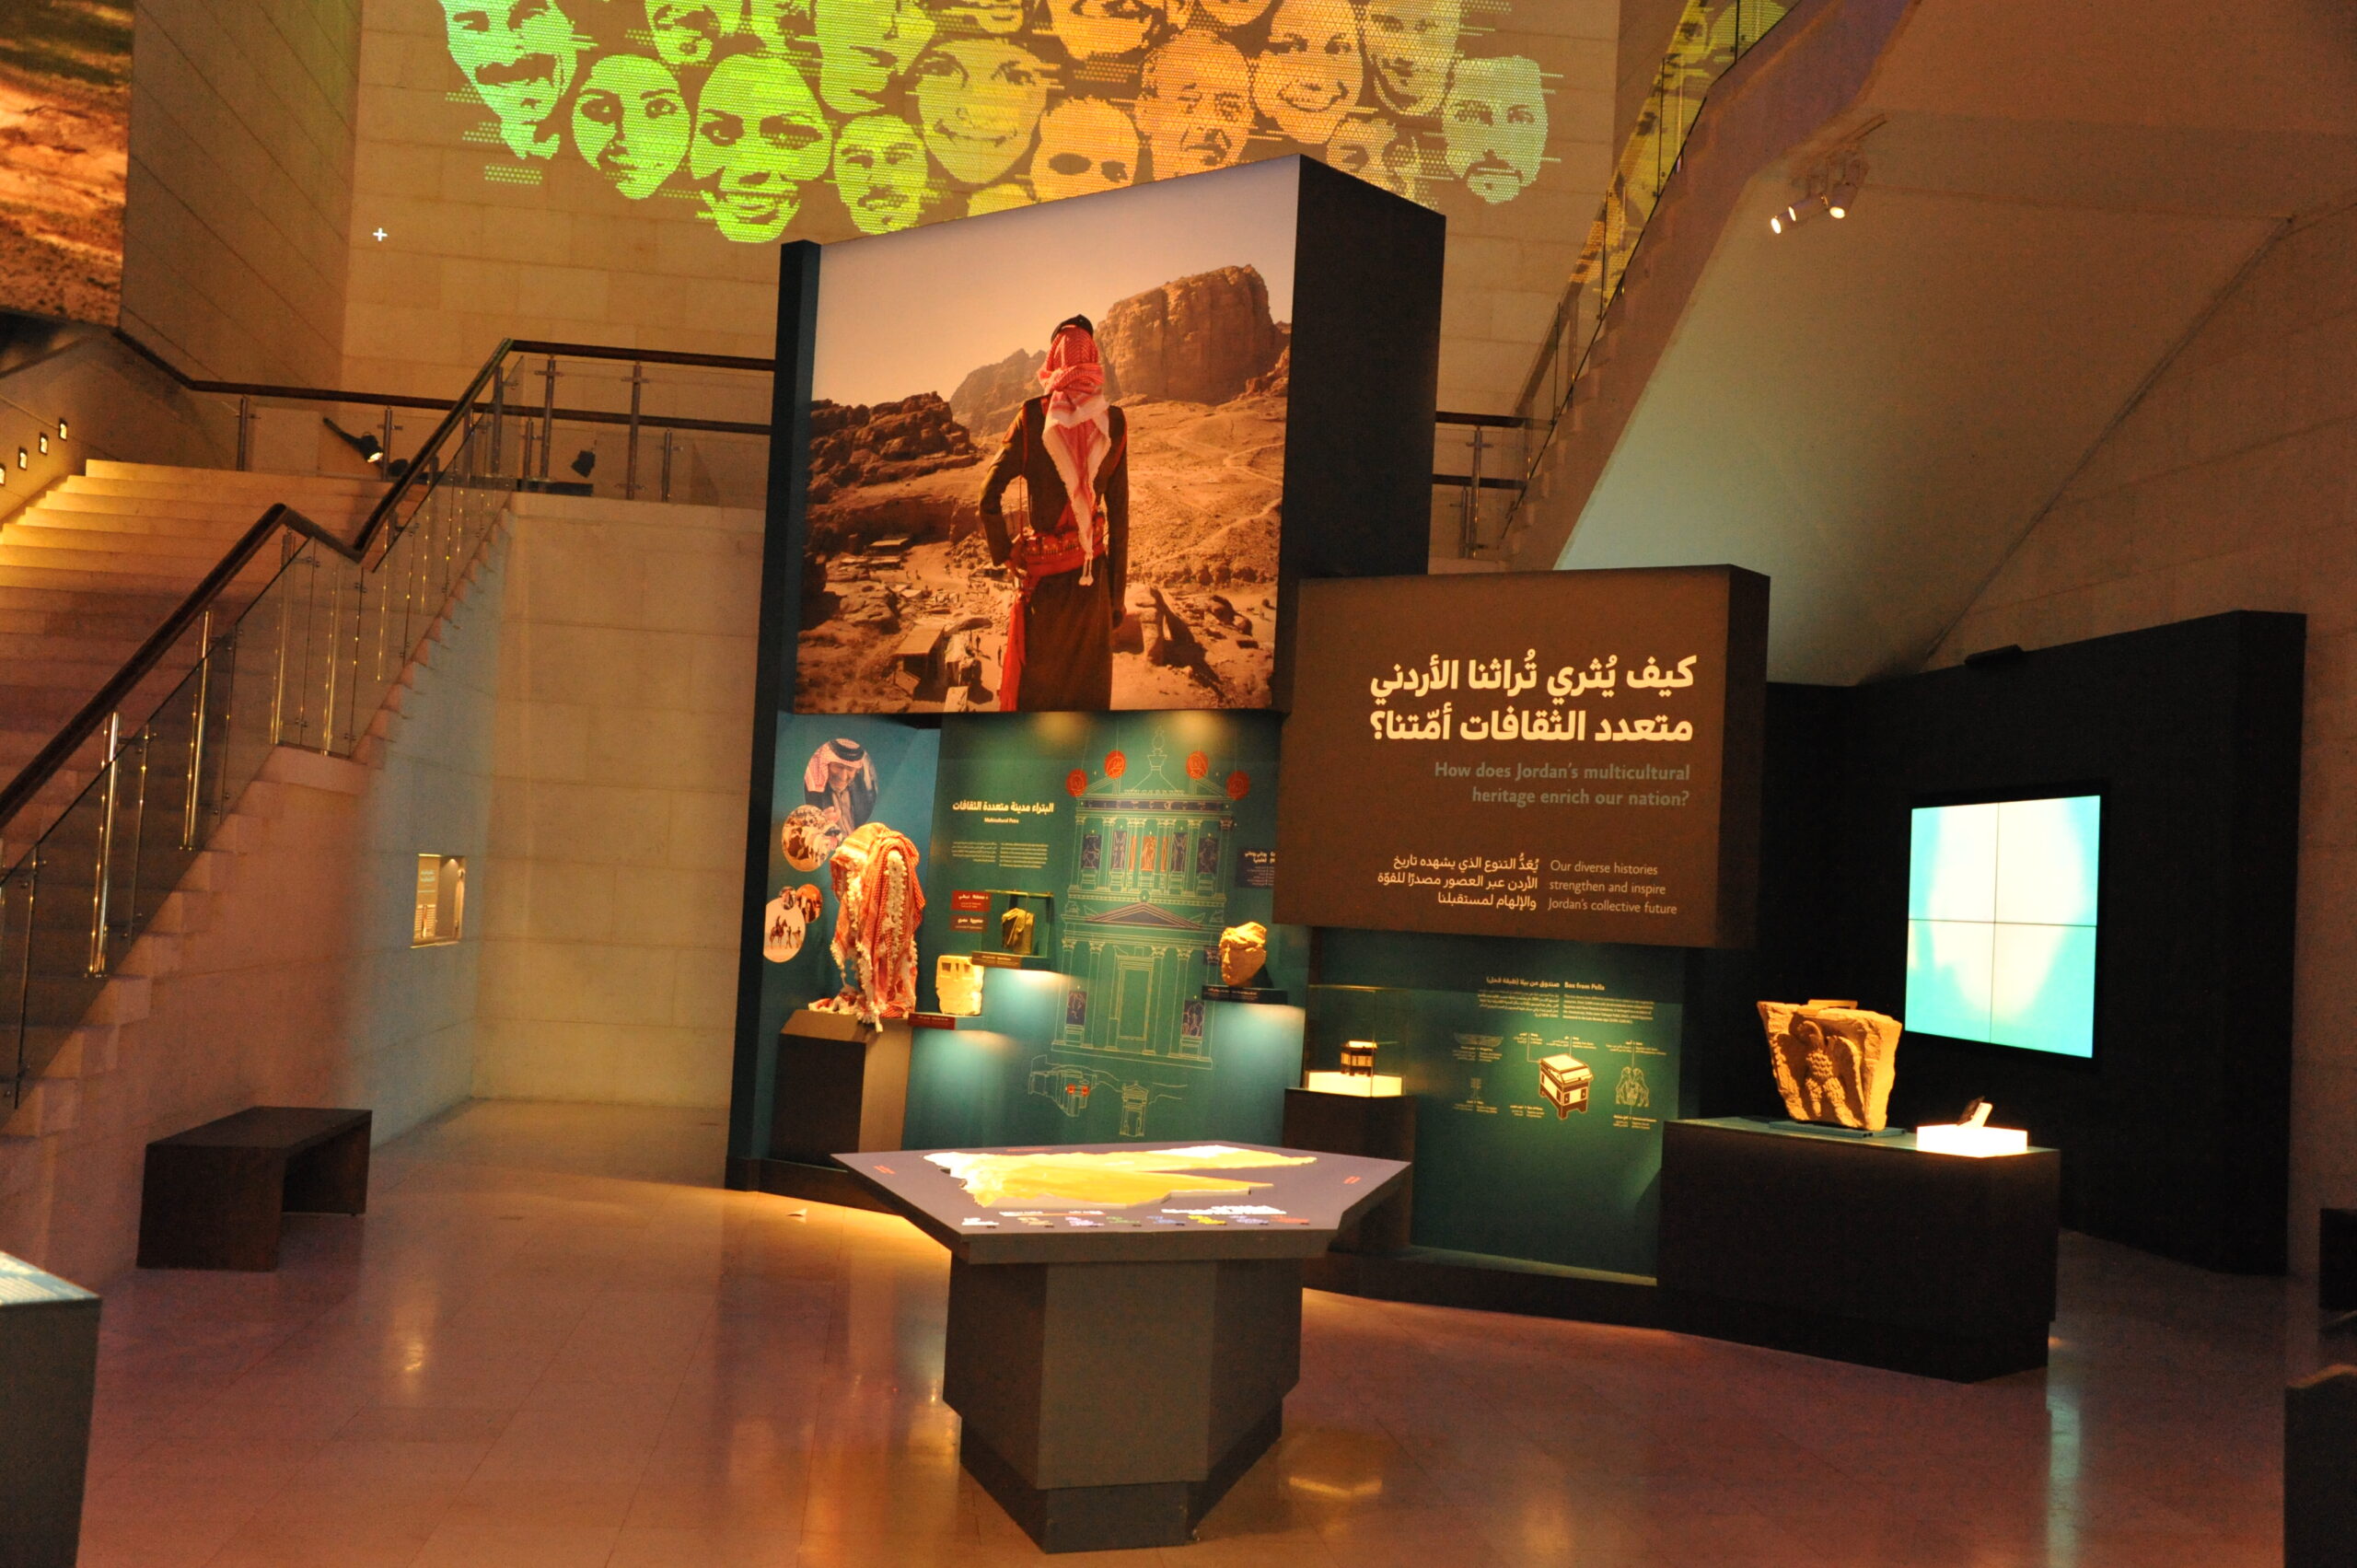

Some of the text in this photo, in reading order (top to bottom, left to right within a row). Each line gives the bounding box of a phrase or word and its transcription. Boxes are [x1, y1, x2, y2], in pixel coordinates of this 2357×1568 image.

[1370, 648, 1697, 705] كيف يُثري تُراثنا الأردني
[1369, 702, 1693, 742] متعدد الثقافات أمّتنا؟
[1434, 761, 1471, 777] How
[1475, 762, 1511, 778] does
[1584, 763, 1690, 781] multicultural
[1472, 786, 1689, 808] heritage enrich our nation?
[1393, 854, 1418, 870] تاريخ
[1420, 856, 1456, 870] يشهده
[1458, 856, 1482, 874] الذي
[1484, 857, 1516, 873] التنوع
[1550, 859, 1658, 875] Our diverse histories
[1443, 875, 1483, 889] العصور
[1485, 878, 1505, 890] عبر
[1507, 877, 1538, 892] الأردن
[1549, 879, 1666, 898] strengthen and inspire
[1437, 891, 1493, 907] لمستقبلنا
[1590, 900, 1641, 912] collective
[1644, 900, 1678, 914] future
